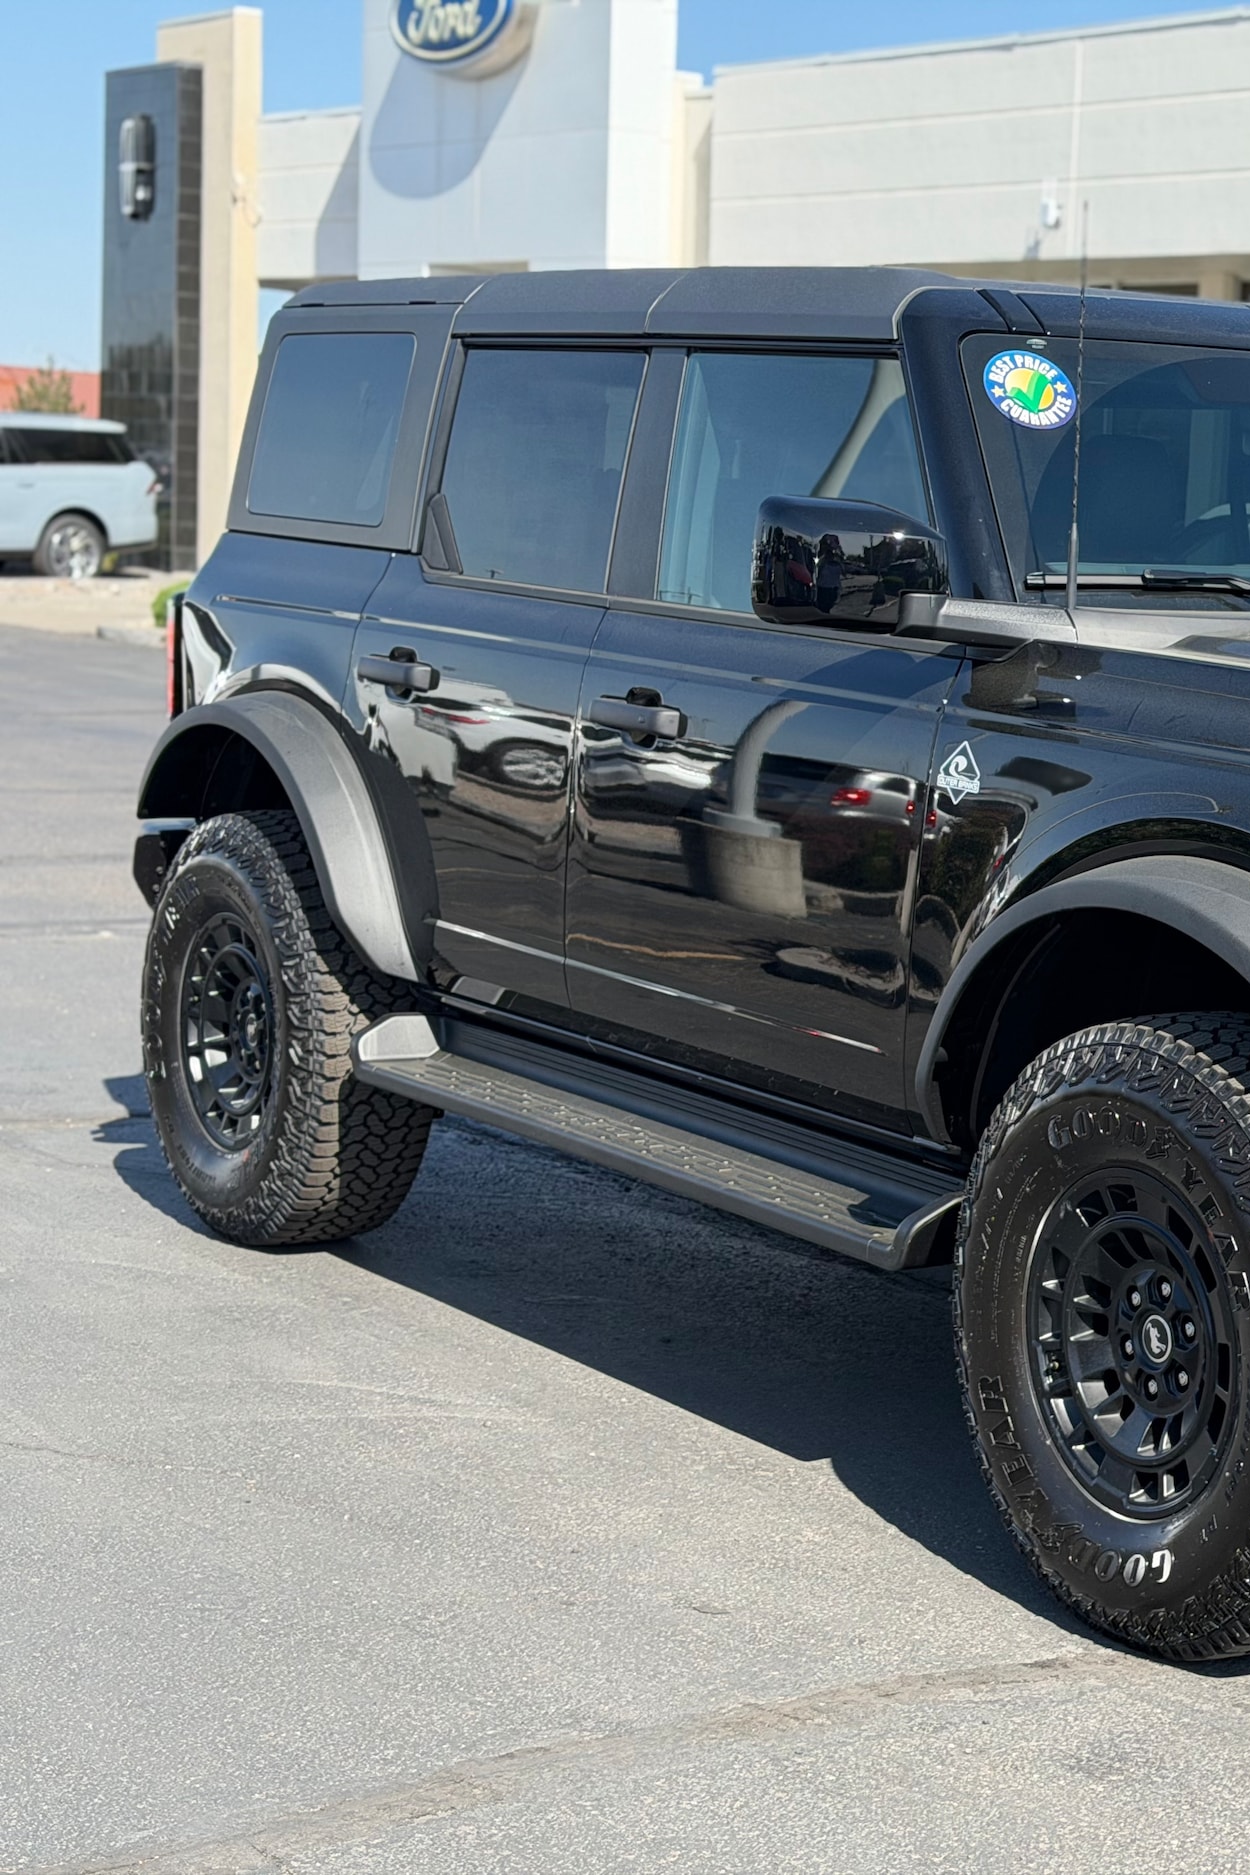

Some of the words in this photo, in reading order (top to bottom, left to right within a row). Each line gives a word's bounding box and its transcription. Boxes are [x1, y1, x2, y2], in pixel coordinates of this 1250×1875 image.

[407, 0, 482, 44] Ford
[988, 355, 1015, 383] BEST
[1013, 354, 1058, 380] PRICE
